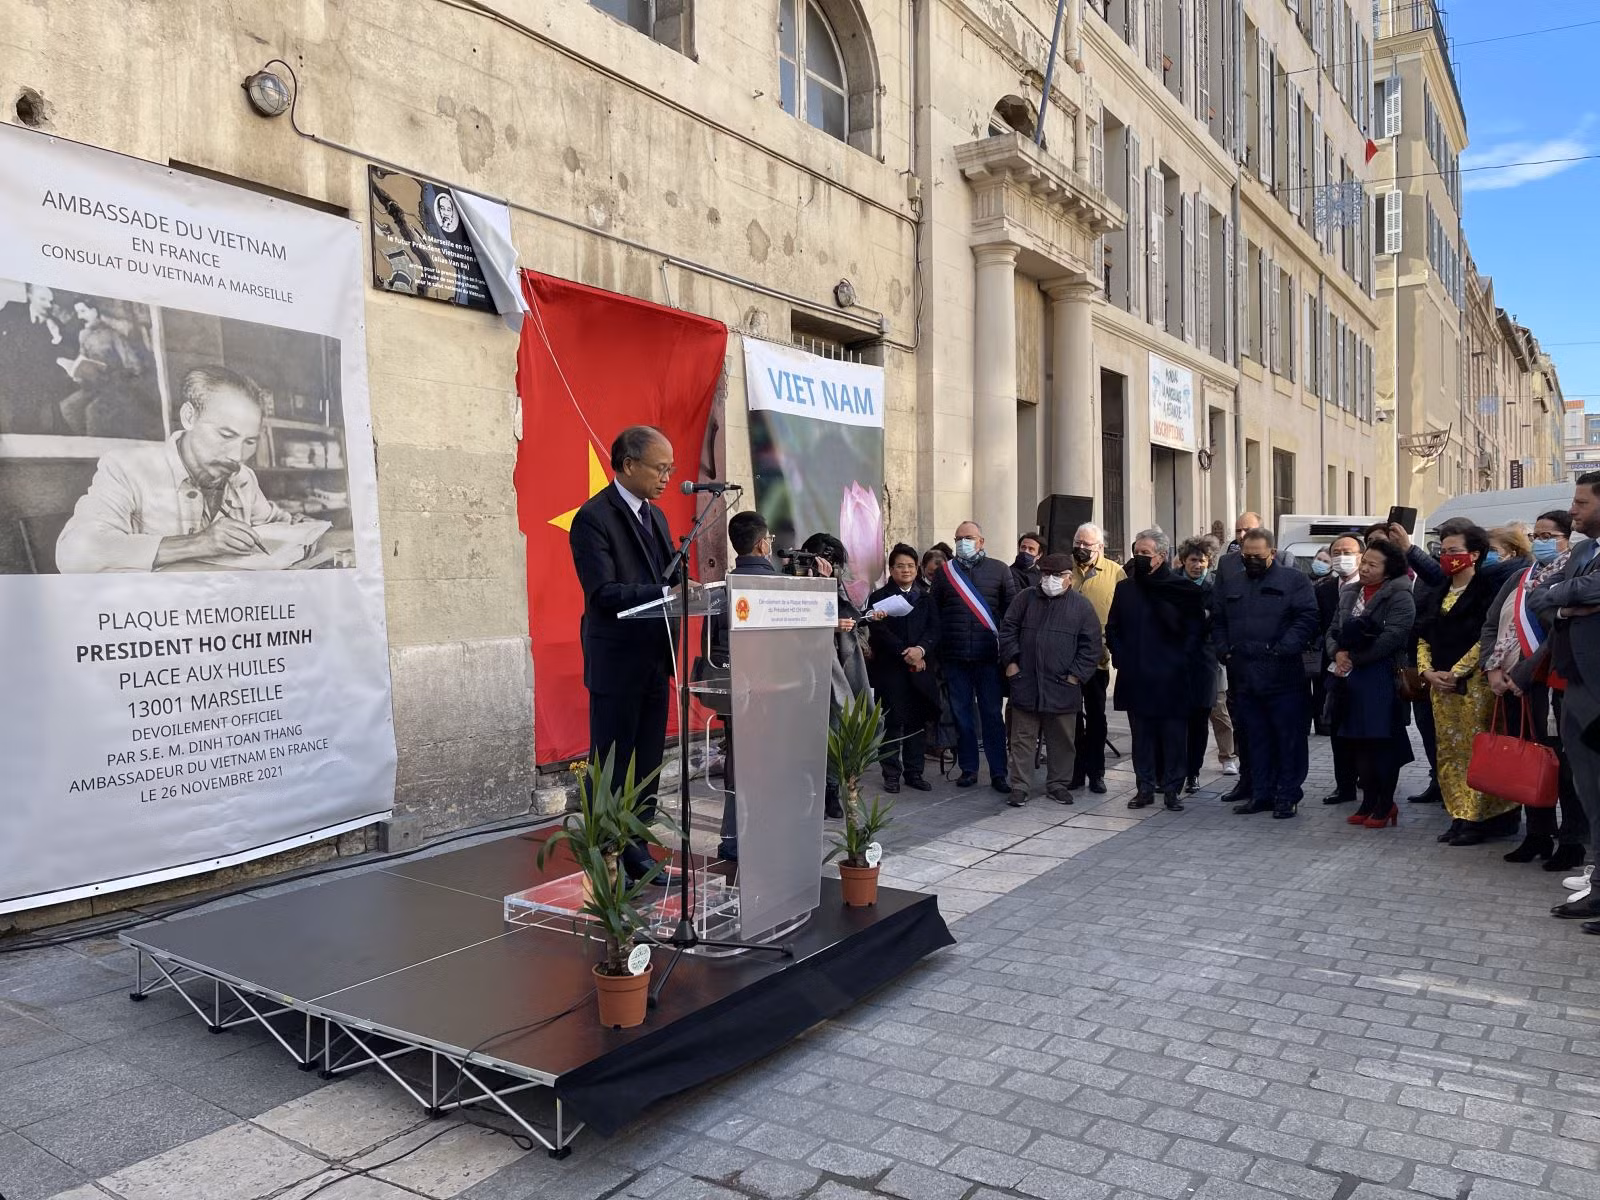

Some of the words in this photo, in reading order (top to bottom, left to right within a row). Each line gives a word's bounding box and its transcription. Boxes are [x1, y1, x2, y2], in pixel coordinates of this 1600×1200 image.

[42, 190, 169, 233] AMBASSADE
[176, 220, 202, 240] DU
[208, 228, 287, 260] VIETNAM
[132, 238, 154, 254] EN
[160, 243, 221, 268] FRANCE
[395, 236, 411, 246] futur
[412, 242, 441, 253] Président
[442, 248, 473, 262] Vietnamien
[428, 236, 454, 248] Marseille
[42, 244, 122, 270] CONSULAT
[128, 260, 148, 274] DU
[153, 264, 214, 288] VIETNAM
[218, 278, 226, 289] A
[230, 280, 293, 303] MARSEILLE
[432, 255, 448, 264] (alias
[448, 259, 459, 267] Van
[768, 368, 815, 406] VIET
[821, 380, 874, 415] NAM
[98, 610, 179, 631] PLAQUE
[186, 604, 296, 625] MEMORIELLE
[76, 638, 193, 662] PRESIDENT
[200, 635, 226, 652] HO
[232, 633, 261, 650] CHI
[267, 629, 312, 646] MINH
[120, 668, 180, 690] PLACE
[186, 664, 223, 682] AUX
[228, 657, 286, 678] HUILES
[128, 697, 182, 719] 13001
[191, 684, 283, 711] MARSEILLE
[132, 716, 228, 741] DEVOILEMENT
[231, 709, 282, 726] OFFICIEL
[107, 751, 136, 766] PAR
[139, 746, 164, 761] S.E.
[168, 744, 185, 756] M.
[190, 739, 223, 754] DINH
[226, 731, 260, 748] TOAN
[264, 724, 302, 741] THANG
[69, 764, 184, 793] AMBASSADEUR
[188, 759, 207, 774] DU
[210, 748, 266, 769] VIETNAM
[270, 746, 285, 759] EN
[288, 738, 328, 754] FRANCE
[141, 788, 156, 802] LE
[161, 786, 177, 799] 26
[181, 770, 254, 796] NOVEMBRE
[257, 765, 283, 780] 2021
